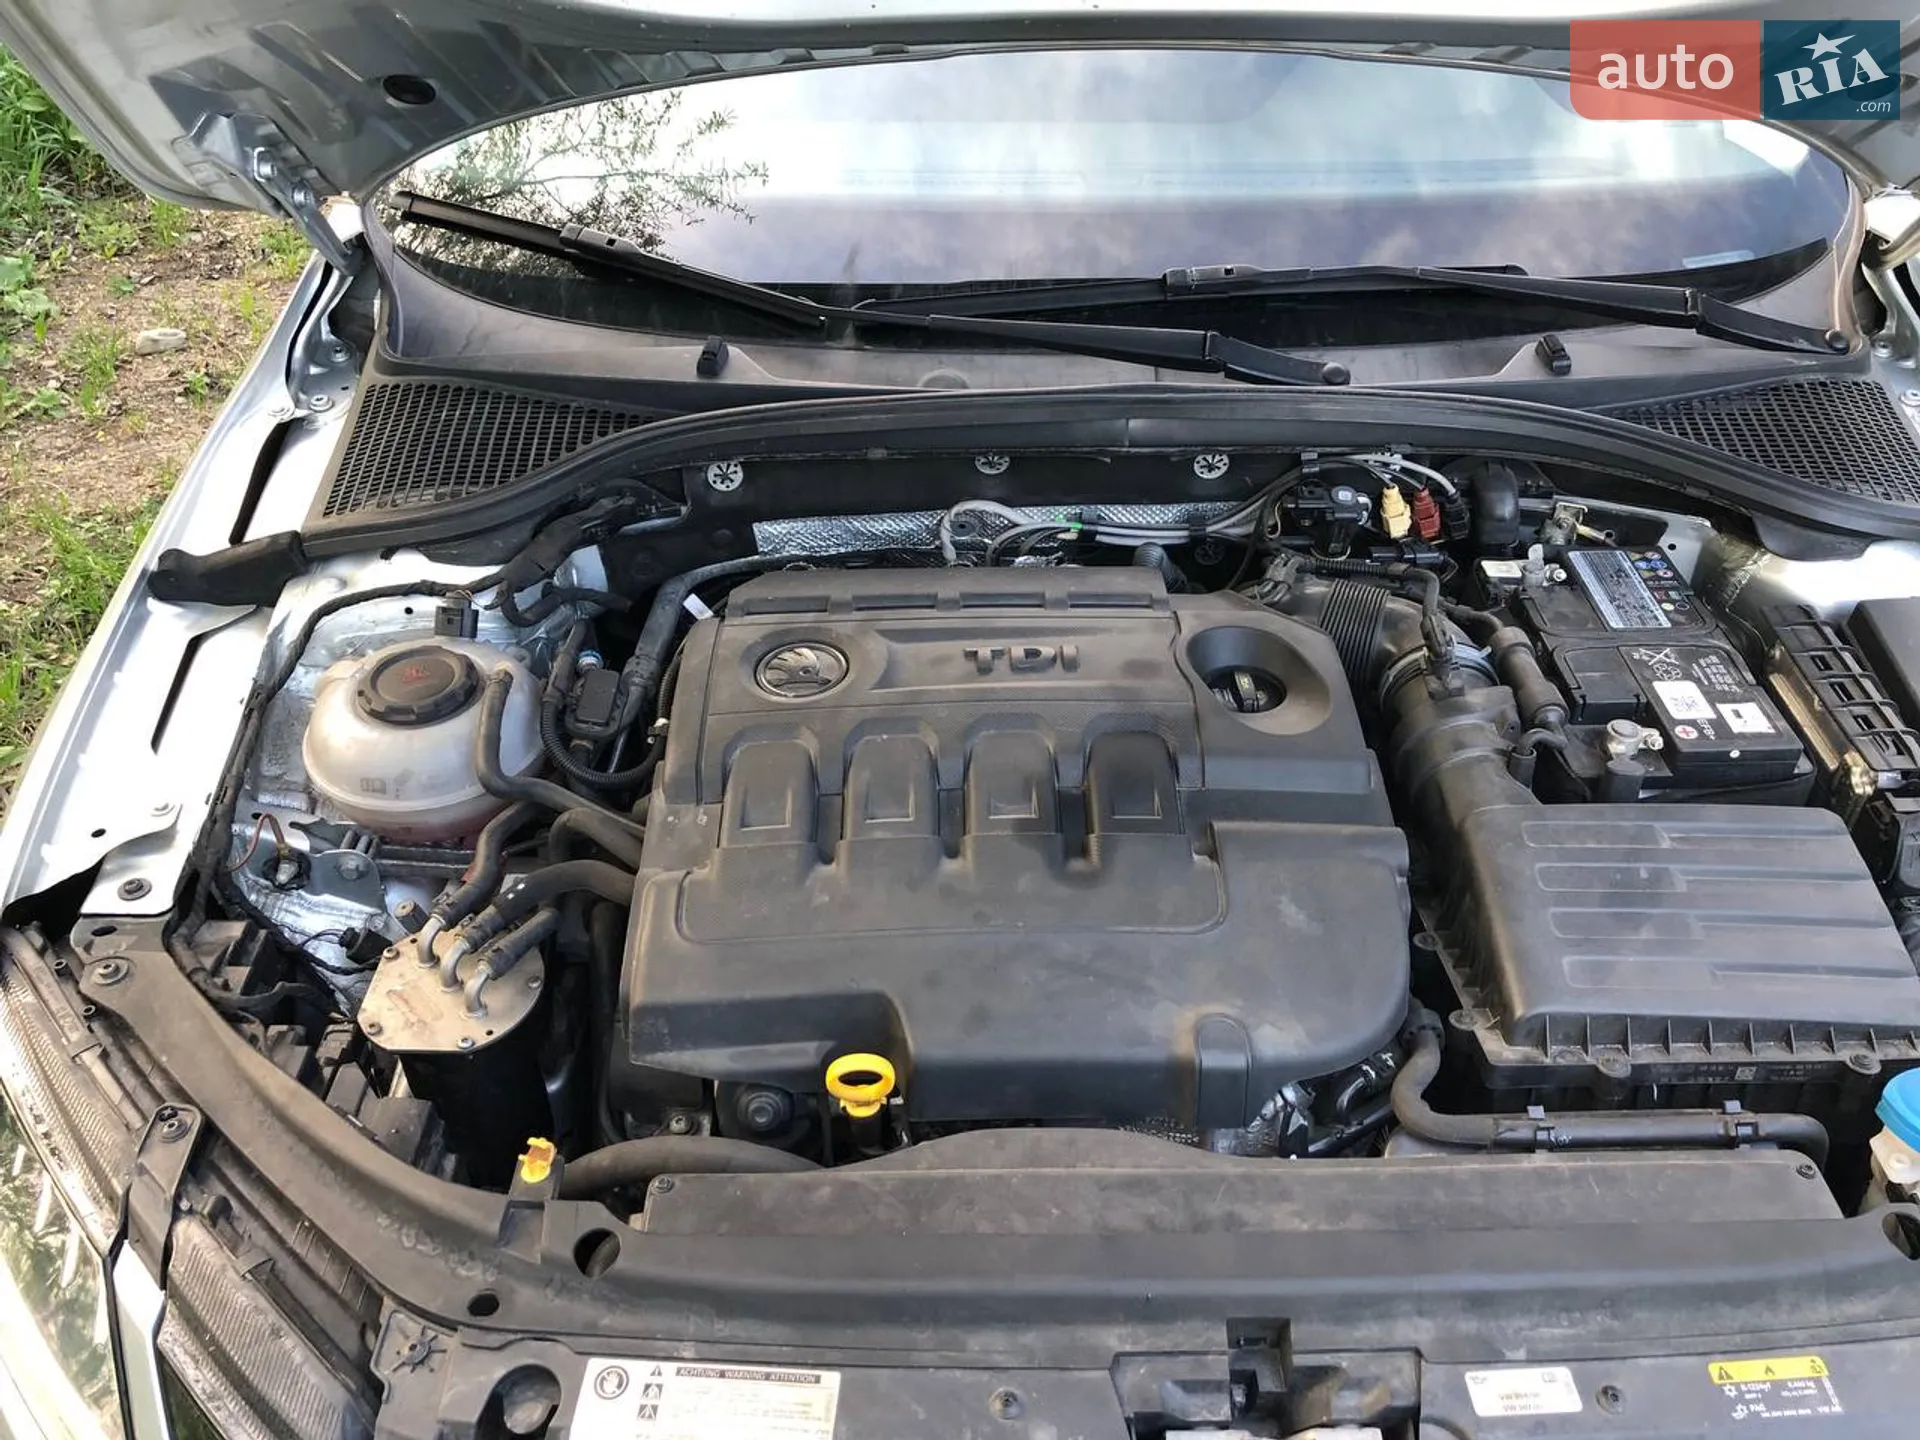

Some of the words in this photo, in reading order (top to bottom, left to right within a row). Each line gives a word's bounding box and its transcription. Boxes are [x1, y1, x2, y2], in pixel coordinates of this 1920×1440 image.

[963, 645, 1081, 675] TDI
[678, 1368, 720, 1378] ACHTUNG
[724, 1370, 766, 1380] WARNING
[769, 1372, 816, 1383] ATTENTION
